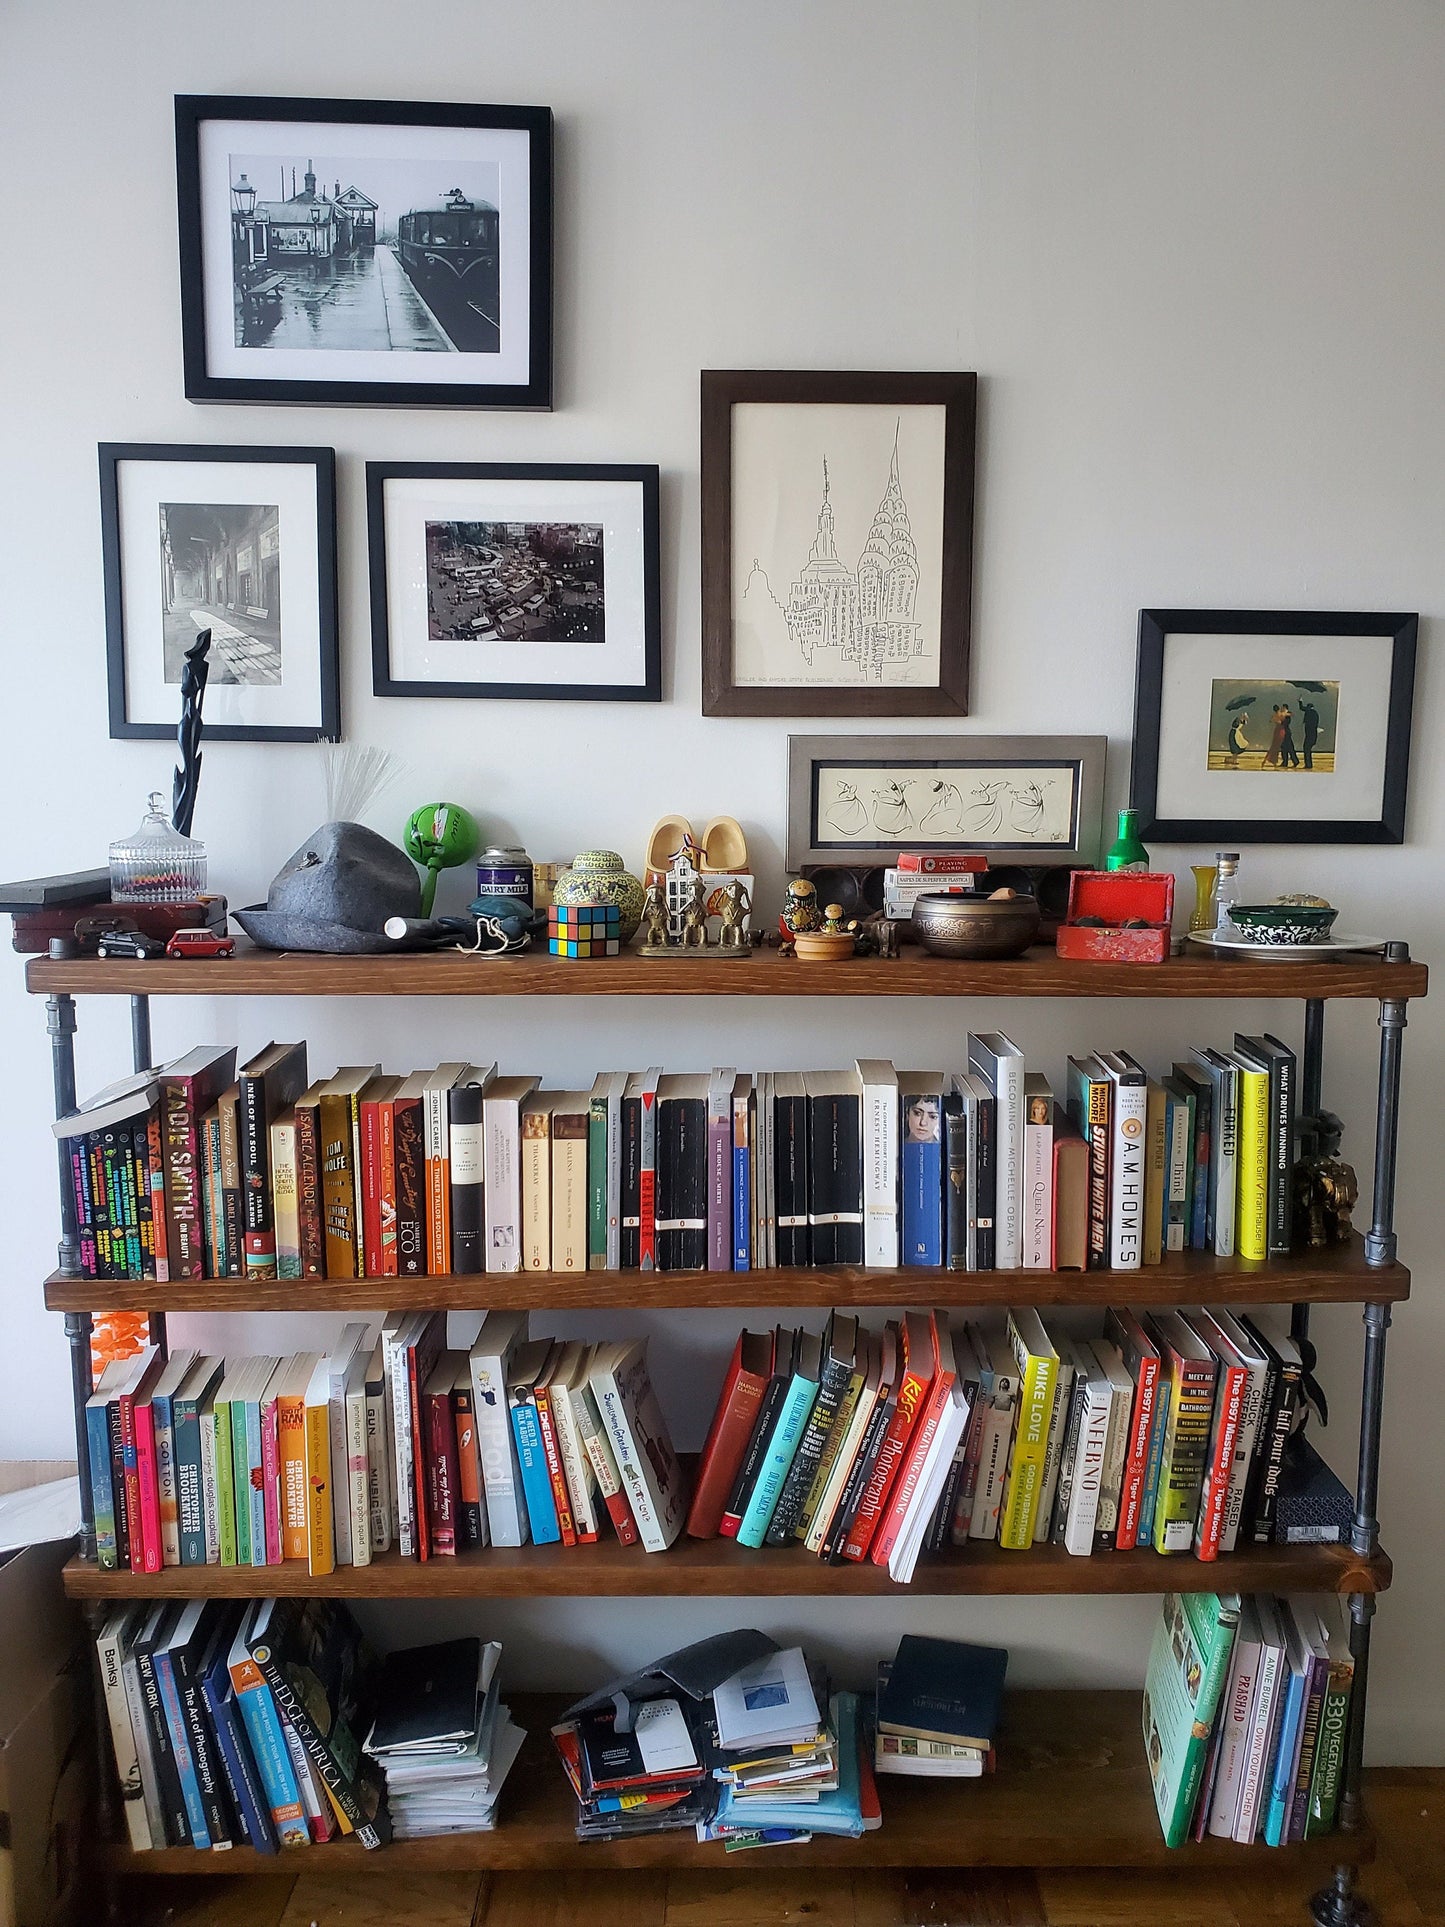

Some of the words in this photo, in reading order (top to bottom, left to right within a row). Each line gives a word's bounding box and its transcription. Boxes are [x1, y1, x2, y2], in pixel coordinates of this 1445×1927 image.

[482, 885, 506, 893] DAIRY
[507, 885, 528, 893] MILK
[1257, 1079, 1267, 1095] The
[1279, 1065, 1289, 1092] WHAT
[247, 1083, 256, 1105] INÉS
[432, 1095, 440, 1114] JOHN
[1007, 1071, 1016, 1131] BECOMING
[1090, 1086, 1099, 1122] MOORE
[1098, 1087, 1106, 1122] MICHAEL
[1255, 1096, 1266, 1117] Myth
[167, 1086, 191, 1146] ZADIE
[248, 1108, 256, 1122] OF
[433, 1116, 440, 1125] LE
[1257, 1119, 1265, 1128] of
[1279, 1094, 1288, 1125] DRIVES
[223, 1105, 234, 1144] Portrait
[249, 1123, 257, 1139] MY
[300, 1110, 315, 1152] ISABEL
[433, 1127, 442, 1150] CARRÉ
[1155, 1119, 1164, 1144] LIAR'S
[1223, 1107, 1236, 1156] FORKED
[1257, 1129, 1265, 1144] the
[225, 1146, 232, 1155] in
[249, 1140, 257, 1166] SOUL
[325, 1140, 343, 1157] TOM
[1092, 1126, 1105, 1173] STUPID
[1154, 1145, 1163, 1170] POKER
[1257, 1146, 1265, 1163] Nice
[1278, 1126, 1287, 1169] WINNING
[169, 1152, 195, 1220] SMITH
[226, 1159, 236, 1186] Sepia
[302, 1154, 315, 1206] ALLENDE
[1007, 1147, 1016, 1201] MICHELLE
[1173, 1160, 1184, 1195] Think
[1256, 1166, 1265, 1180] Girl
[227, 1195, 235, 1220] ISABEL
[249, 1191, 257, 1228] ALLENDE
[642, 1177, 653, 1238] CHANDLER
[1033, 1181, 1046, 1216] QUEEN
[1091, 1176, 1104, 1218] WHITE
[1255, 1192, 1264, 1210] Fran
[1006, 1206, 1015, 1247] OBAMA
[1255, 1212, 1263, 1241] Hauser
[1277, 1198, 1285, 1229] LEDBETTER
[179, 1223, 188, 1237] ON
[228, 1222, 238, 1258] ALLENDE
[401, 1220, 415, 1254] ECO
[1034, 1218, 1044, 1246] NOOR
[1091, 1219, 1103, 1253] MEN
[103, 1229, 111, 1263] DOUGLAS
[179, 1238, 190, 1259] BEAUTY
[1033, 1361, 1051, 1402] MIKE
[1145, 1364, 1157, 1386] The
[1188, 1373, 1203, 1381] MEET
[1234, 1373, 1245, 1394] The
[1053, 1382, 1063, 1411] VISIBLE
[1141, 1386, 1154, 1412] 1997
[1190, 1388, 1197, 1396] IN
[353, 1403, 365, 1430] jennifer
[516, 1409, 525, 1426] TALK
[525, 1408, 533, 1419] WE
[540, 1411, 549, 1431] CHE
[782, 1391, 809, 1443] HALLUCINATIONS
[1153, 1385, 1167, 1429] HOWLING
[1229, 1396, 1242, 1421] 1997
[1247, 1389, 1260, 1427] CHUCK
[1275, 1409, 1293, 1432] kill
[110, 1406, 123, 1461] PERFUME
[518, 1426, 529, 1446] ABOUT
[527, 1420, 535, 1436] NEED
[1026, 1403, 1044, 1444] LOVE
[1050, 1413, 1058, 1431] MAN
[1135, 1413, 1150, 1458] Masters
[204, 1424, 214, 1454] eleanor
[353, 1431, 363, 1448] egan
[530, 1438, 538, 1447] TO
[911, 1418, 938, 1471] BEGINNING
[1081, 1405, 1108, 1491] INFERNO
[1152, 1430, 1159, 1443] AT
[1220, 1422, 1237, 1469] Masters
[1267, 1433, 1288, 1464] your
[203, 1455, 212, 1475] rigby
[523, 1447, 533, 1467] KEVIN
[541, 1430, 559, 1474] GUEVARA
[991, 1433, 1000, 1469] ANTHONY
[1041, 1441, 1053, 1488] KLOSTERMAN
[1149, 1444, 1158, 1462] THE
[159, 1440, 171, 1497] COTTON
[356, 1461, 364, 1474] visit
[860, 1438, 904, 1521] Photography
[1025, 1463, 1036, 1488] GOOD
[1146, 1463, 1156, 1491] MOON
[1263, 1465, 1281, 1496] idols
[205, 1476, 215, 1507] douglas
[285, 1460, 297, 1528] BROOKMYRE
[294, 1459, 306, 1528] CHRISTOPHER
[357, 1477, 365, 1491] from
[370, 1468, 379, 1508] MUSIC
[569, 1474, 582, 1502] Number
[763, 1470, 781, 1497] OLIVER
[895, 1470, 921, 1517] GLIDING
[986, 1469, 995, 1497] KIEDIS
[1129, 1476, 1140, 1499] Tiger
[179, 1464, 192, 1533] BROOKMYRE
[188, 1463, 201, 1533] CHRISTOPHER
[357, 1493, 365, 1505] the
[574, 1502, 584, 1517] Ten
[755, 1496, 772, 1518] SACKS
[1213, 1487, 1225, 1510] Tiger
[1229, 1488, 1243, 1527] RAISED
[207, 1508, 219, 1546] coupland
[355, 1506, 363, 1523] goon
[1017, 1488, 1034, 1546] VIBRATIONS
[1127, 1501, 1138, 1530] Woods
[1209, 1512, 1221, 1542] Woods
[357, 1524, 366, 1545] squad
[104, 1648, 119, 1688] Banksy
[139, 1654, 154, 1682] NEW
[265, 1665, 282, 1691] THE
[1262, 1657, 1277, 1686] ANNE
[144, 1680, 160, 1709] YORK
[184, 1687, 195, 1707] The
[275, 1684, 307, 1726] EDGE
[1233, 1675, 1251, 1723] PRASHAD
[1257, 1686, 1273, 1724] BURRELL
[188, 1708, 200, 1728] Art
[1325, 1696, 1347, 1731] 330
[193, 1728, 204, 1738] of
[299, 1723, 313, 1740] OF
[1251, 1727, 1265, 1748] OWN
[195, 1736, 214, 1794] Photography
[305, 1737, 341, 1790] AFRICA
[1247, 1748, 1262, 1774] YOUR
[1322, 1730, 1342, 1799] VEGETARIAN
[1241, 1774, 1257, 1818] KITCHEN
